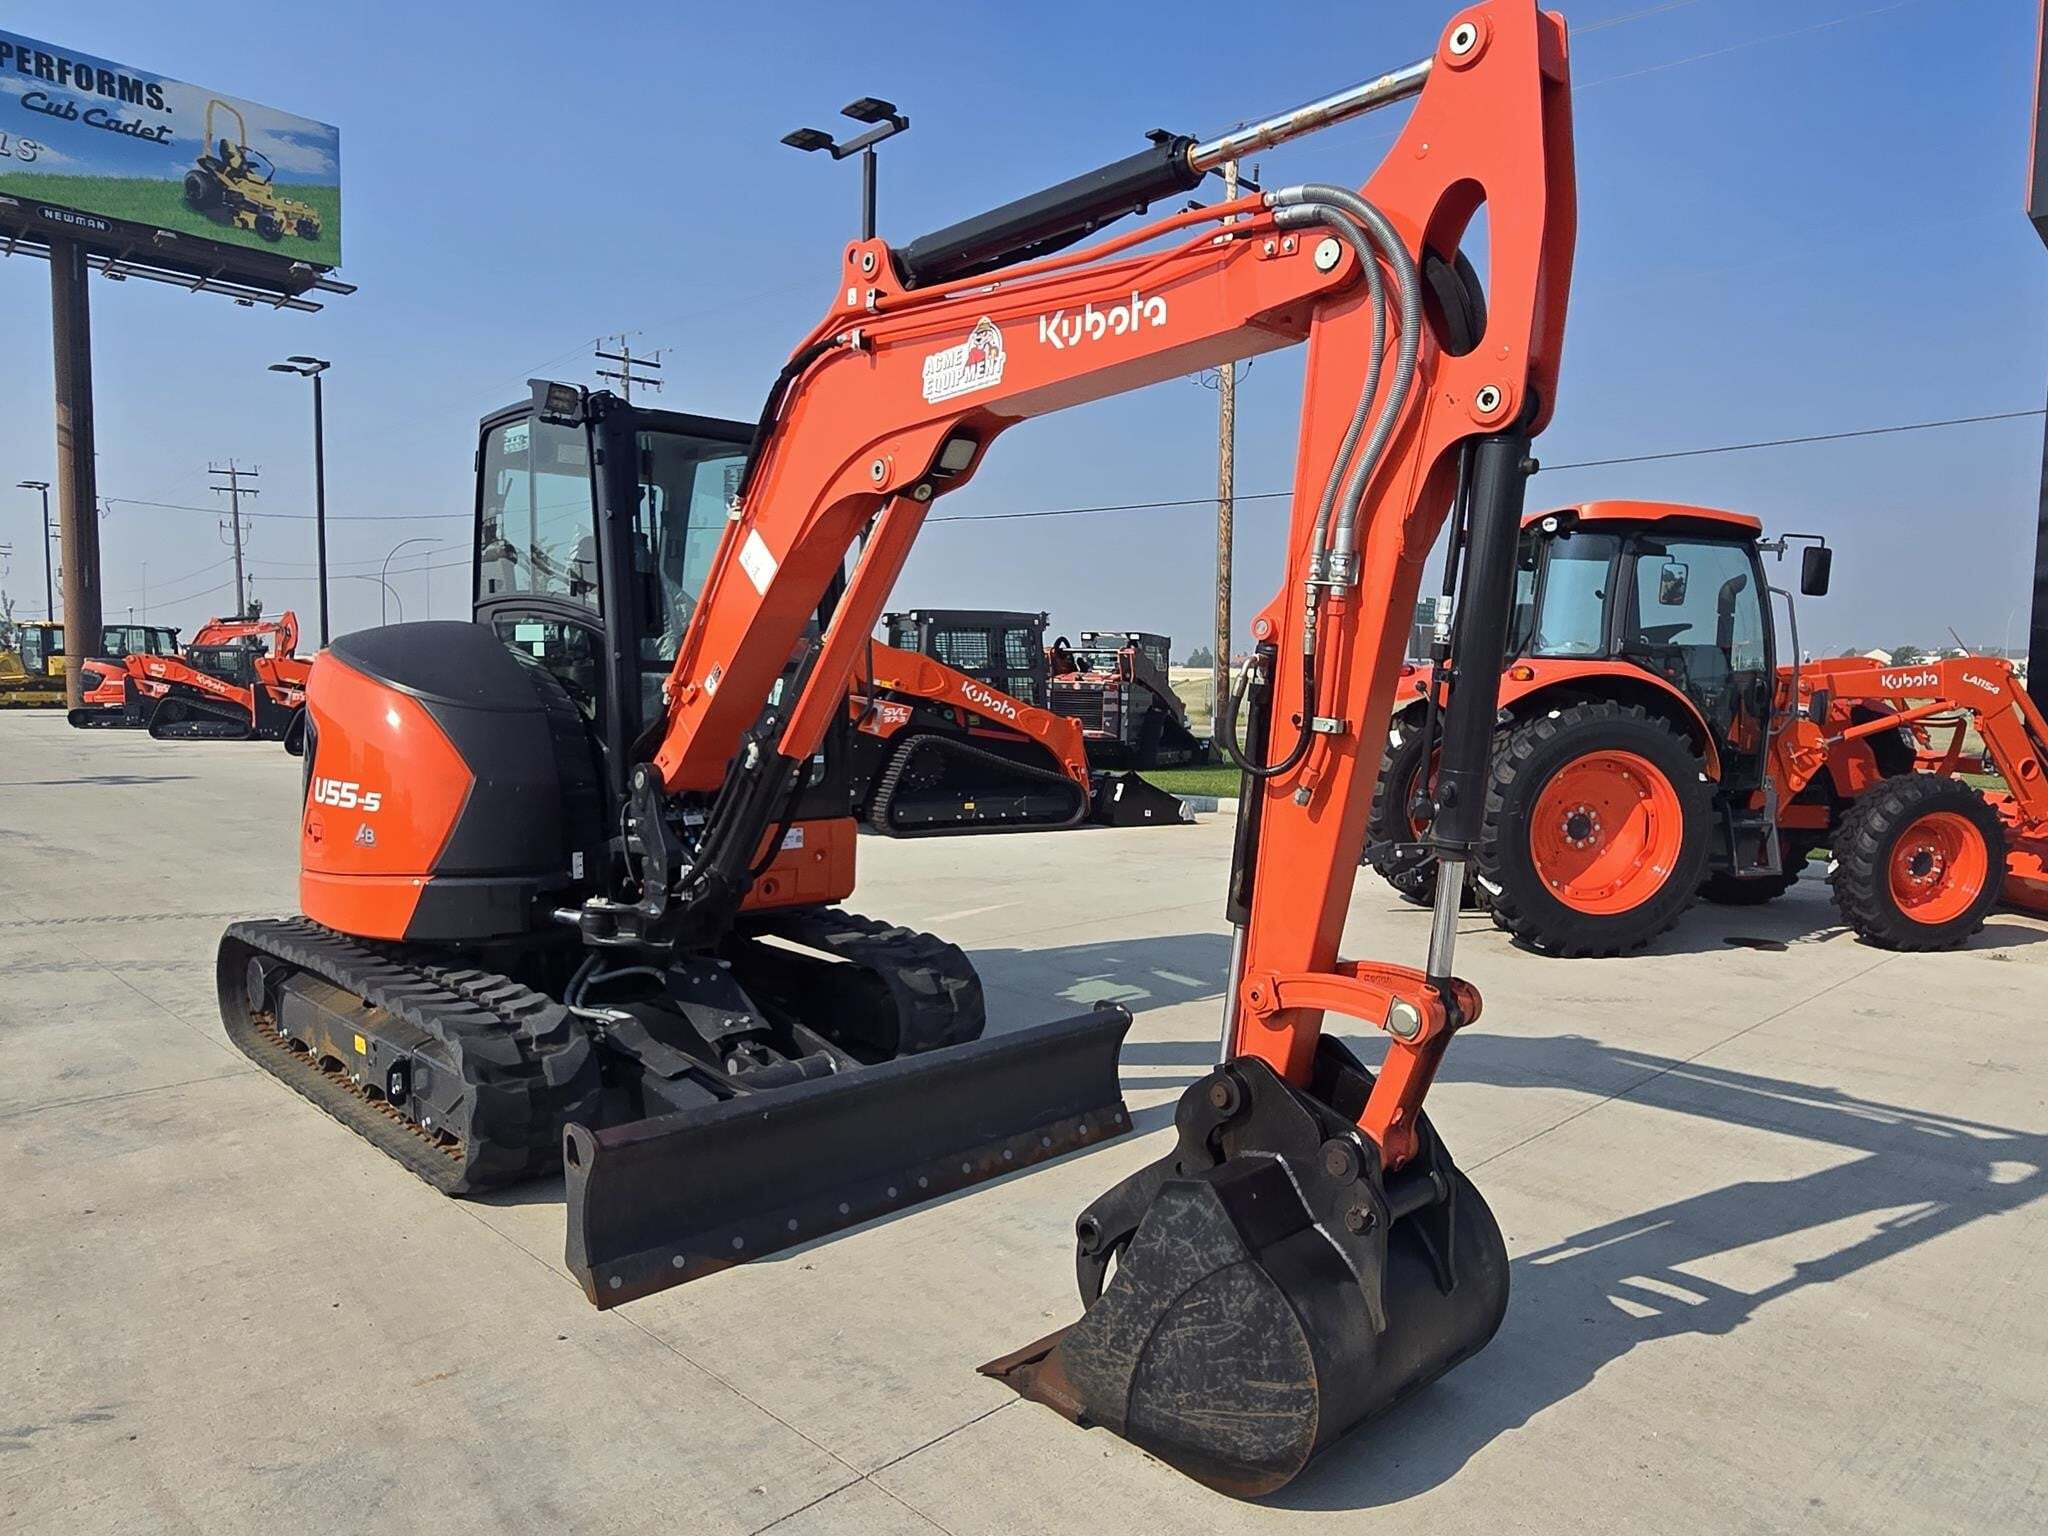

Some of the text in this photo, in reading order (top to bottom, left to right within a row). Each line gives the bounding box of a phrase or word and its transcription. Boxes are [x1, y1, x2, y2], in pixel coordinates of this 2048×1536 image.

[0, 41, 173, 113] PERFORMS.
[21, 92, 173, 145] Cub Cadet
[44, 209, 105, 230] NEWMAN
[1039, 290, 1167, 349] Kubota
[925, 357, 1004, 395] EQUIPMENT
[926, 350, 963, 376] ACME
[1881, 671, 1938, 689] Kubota
[883, 707, 908, 716] SVL
[961, 681, 1016, 720] Kubota
[315, 776, 382, 812] U55-5
